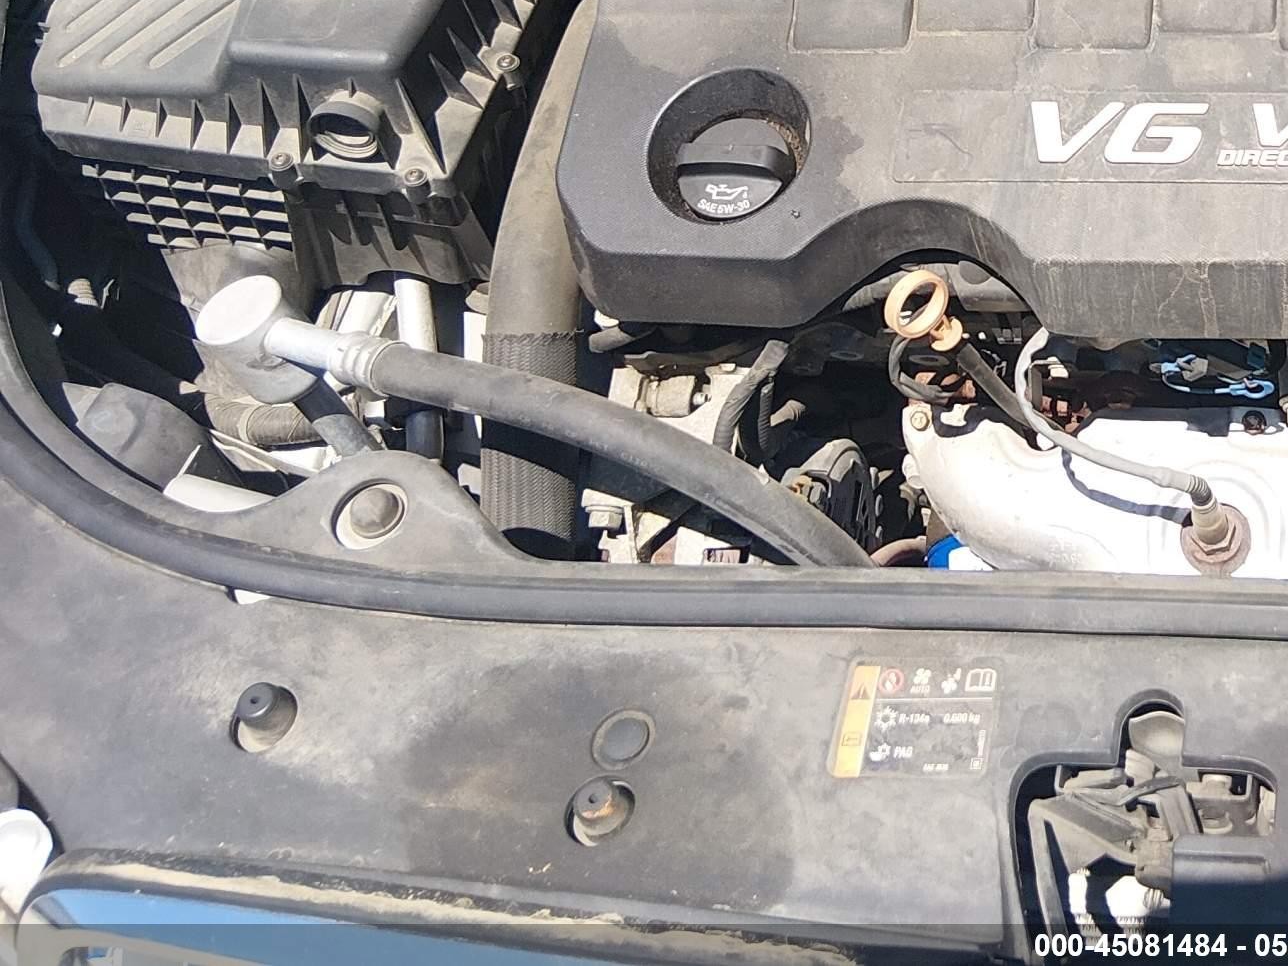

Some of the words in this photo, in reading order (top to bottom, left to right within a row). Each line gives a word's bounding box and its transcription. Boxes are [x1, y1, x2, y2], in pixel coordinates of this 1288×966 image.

[1030, 100, 1210, 165] V6
[697, 198, 717, 213] SAE
[717, 199, 750, 214] 5W-30
[894, 746, 912, 758] PAG
